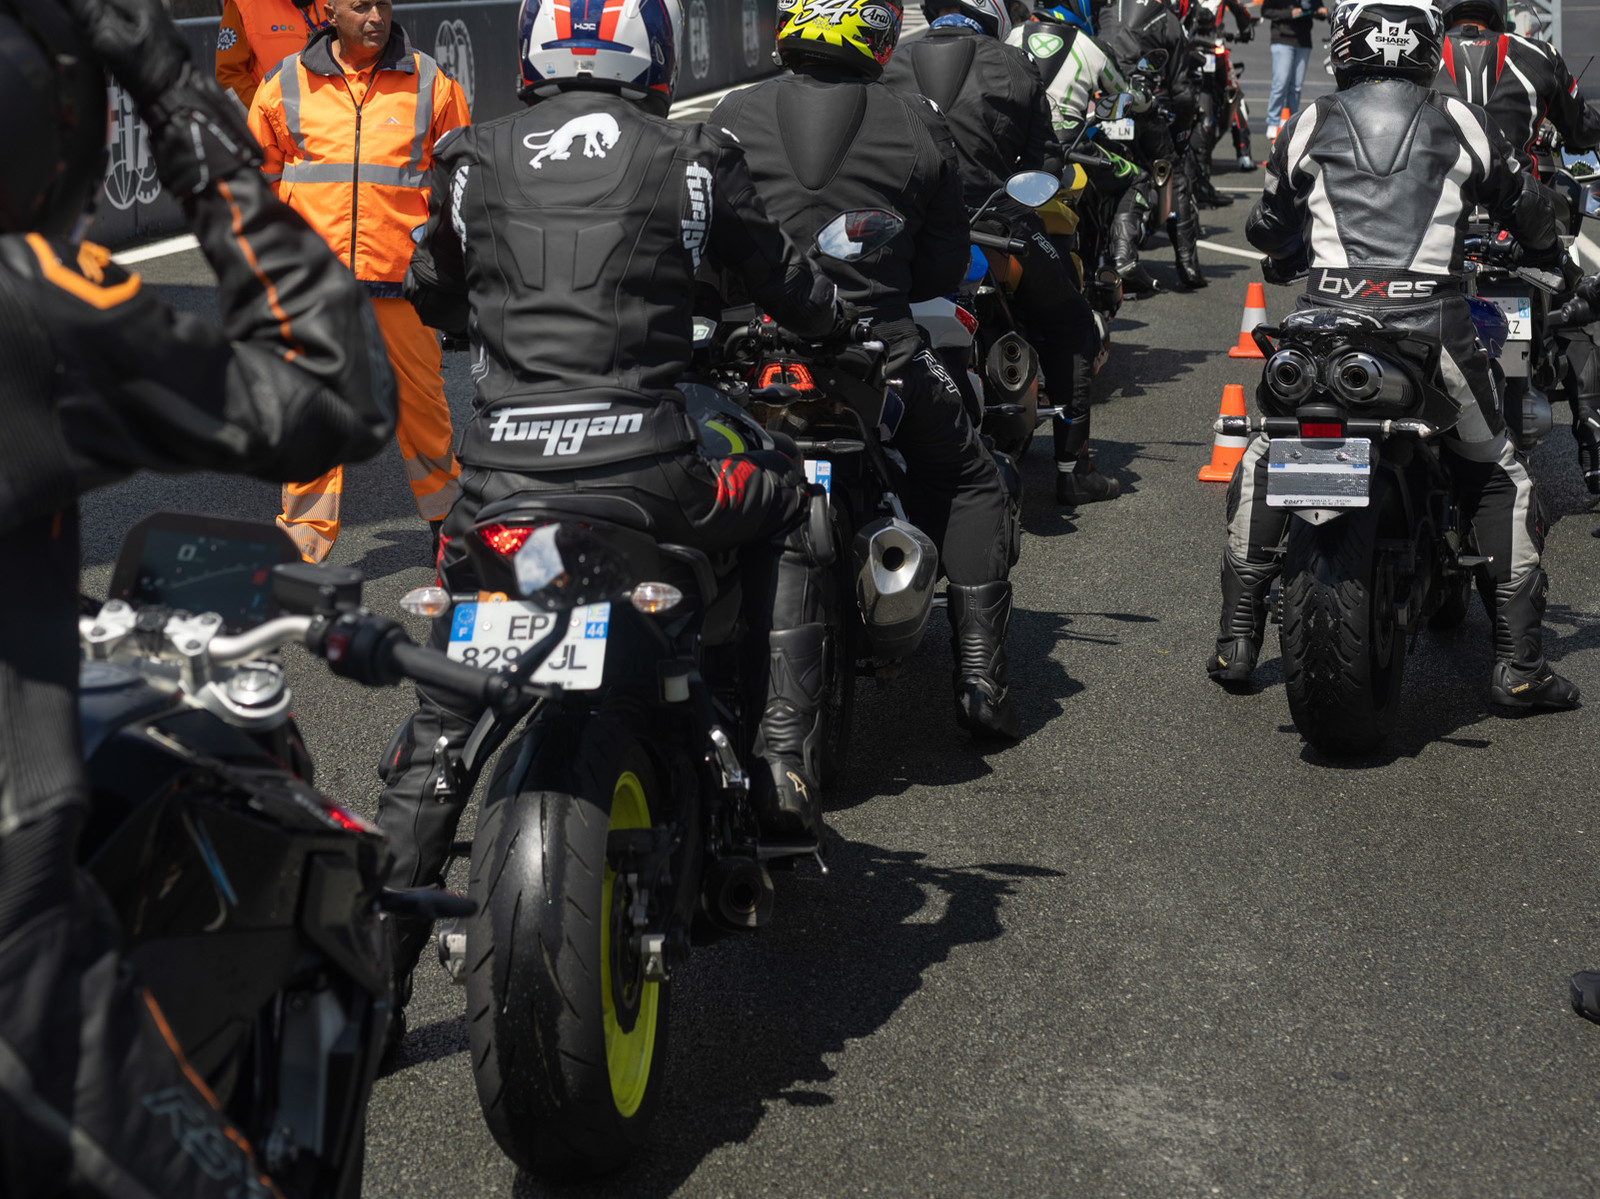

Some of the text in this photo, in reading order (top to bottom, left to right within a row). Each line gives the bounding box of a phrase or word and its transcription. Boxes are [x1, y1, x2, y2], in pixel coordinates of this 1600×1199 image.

[866, 8, 889, 23] Arai
[574, 22, 597, 31] HJC
[1375, 35, 1411, 45] SHARK
[1031, 231, 1060, 259] RST
[1318, 268, 1438, 299] byxes
[489, 402, 643, 456] furygan
[458, 627, 468, 637] F
[508, 615, 549, 640] EP
[587, 624, 605, 637] 44
[548, 645, 587, 670] JL
